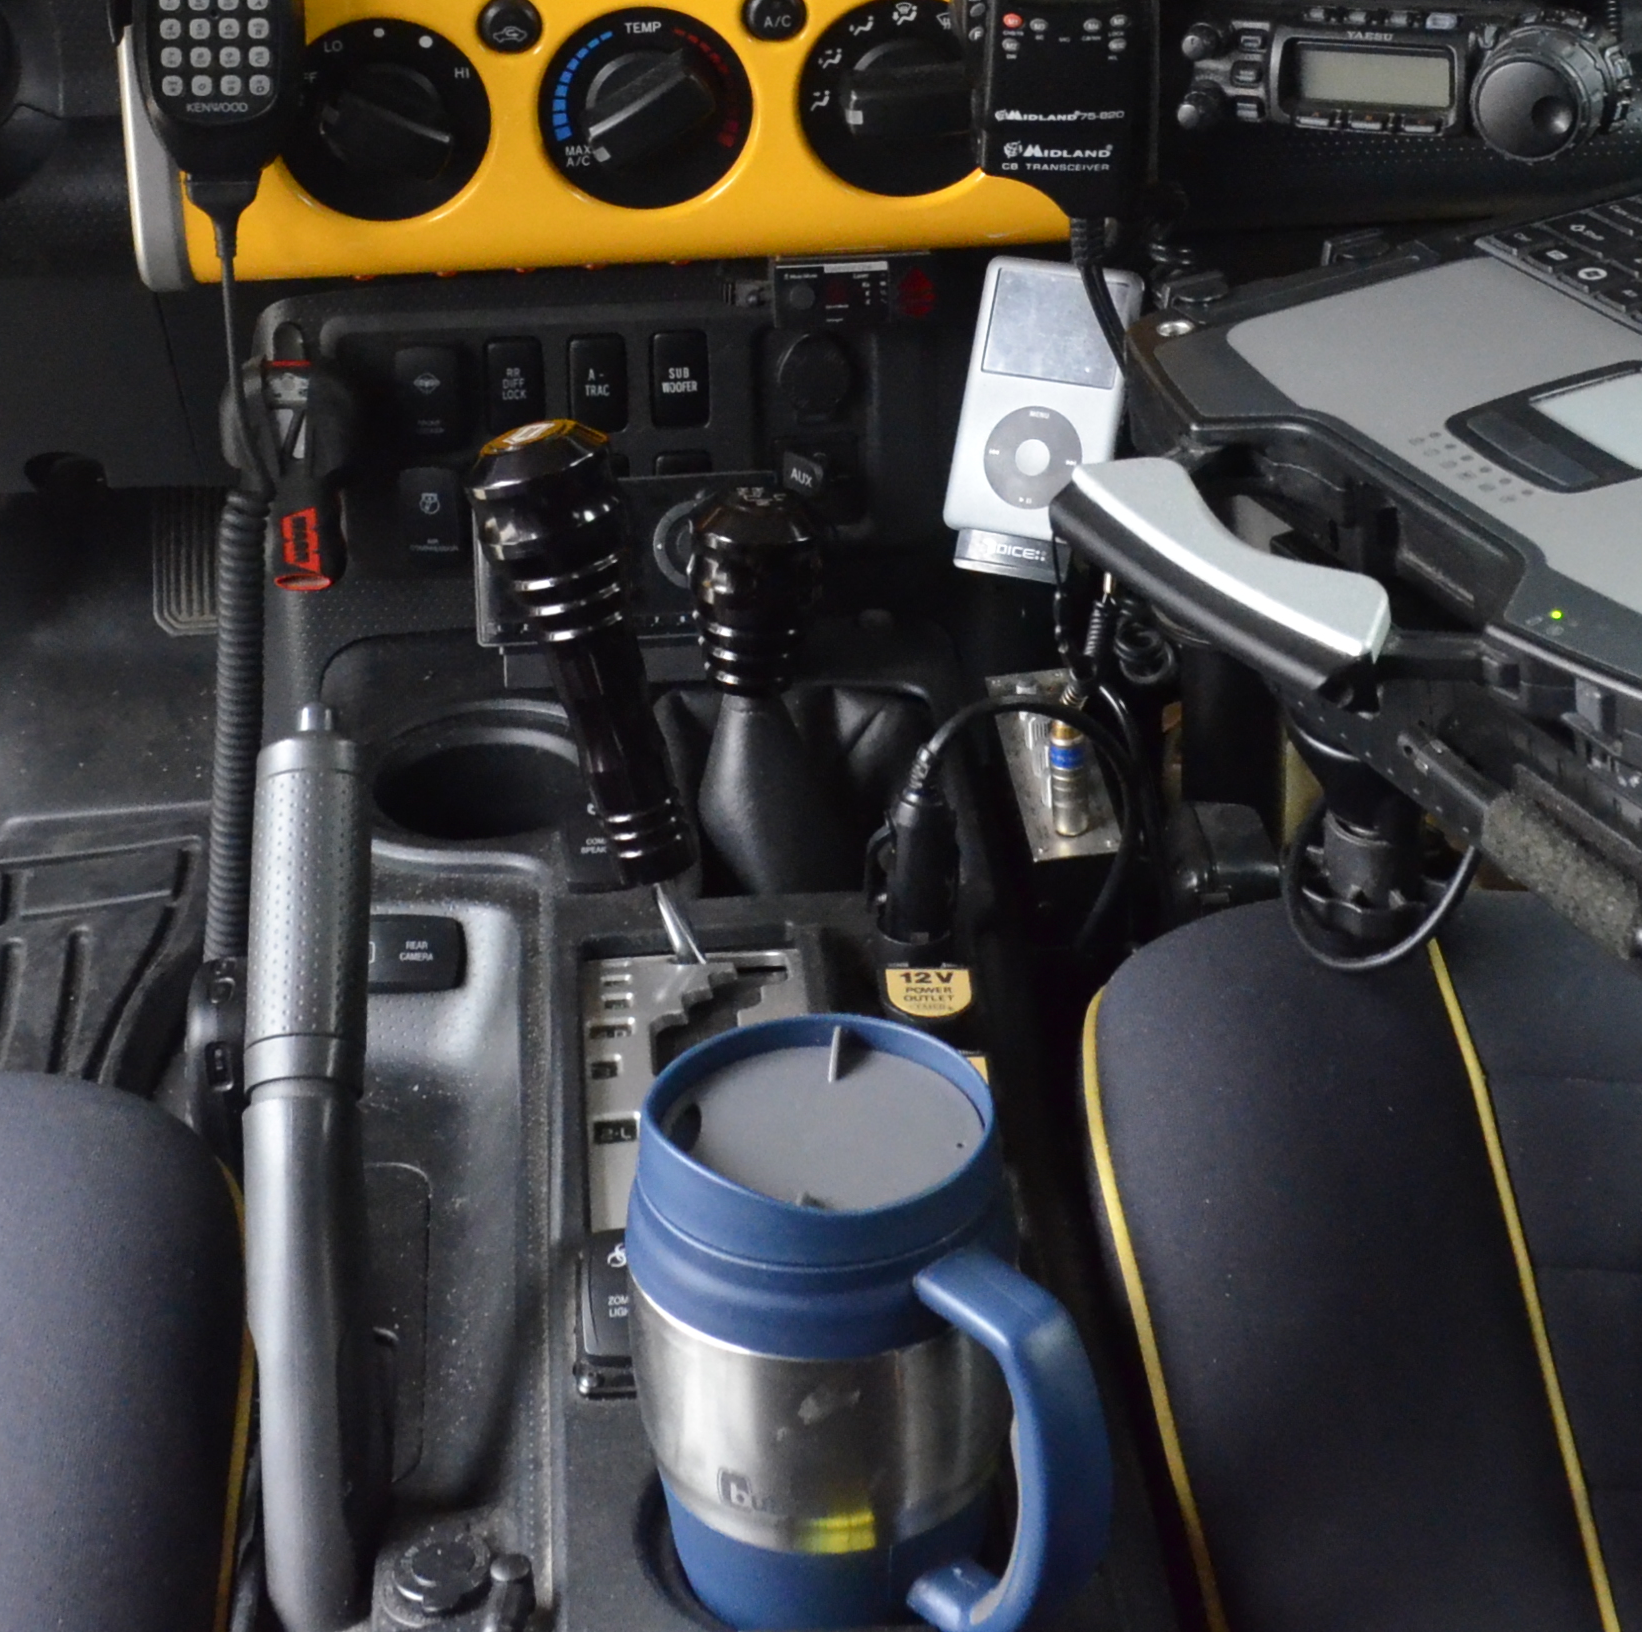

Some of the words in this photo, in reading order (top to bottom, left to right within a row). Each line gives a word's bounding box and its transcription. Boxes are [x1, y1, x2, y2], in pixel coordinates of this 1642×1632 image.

[763, 14, 793, 29] A/C
[624, 21, 662, 35] TEMP
[973, 30, 981, 40] F
[1347, 30, 1394, 42] YAESU
[323, 39, 344, 53] LO
[454, 67, 471, 80] HI
[186, 102, 249, 113] KENWOOD
[1006, 110, 1078, 122] MIDLAND
[564, 144, 592, 156] MAX
[1022, 144, 1112, 158] MIDLAND
[565, 155, 591, 167] A/C
[1001, 162, 1018, 171] CB
[1025, 163, 1110, 172] TRANSCEIVER
[588, 368, 596, 381] A
[668, 367, 690, 379] SUB
[584, 384, 610, 397] TRAC
[661, 380, 698, 394] WOOFER
[502, 389, 527, 401] LOCK
[1029, 410, 1051, 419] MENU
[790, 467, 813, 488] AUX
[405, 941, 429, 950] REAR
[399, 951, 434, 962] CAMERA
[905, 986, 953, 994] POWER
[903, 994, 955, 1002] OUTLET
